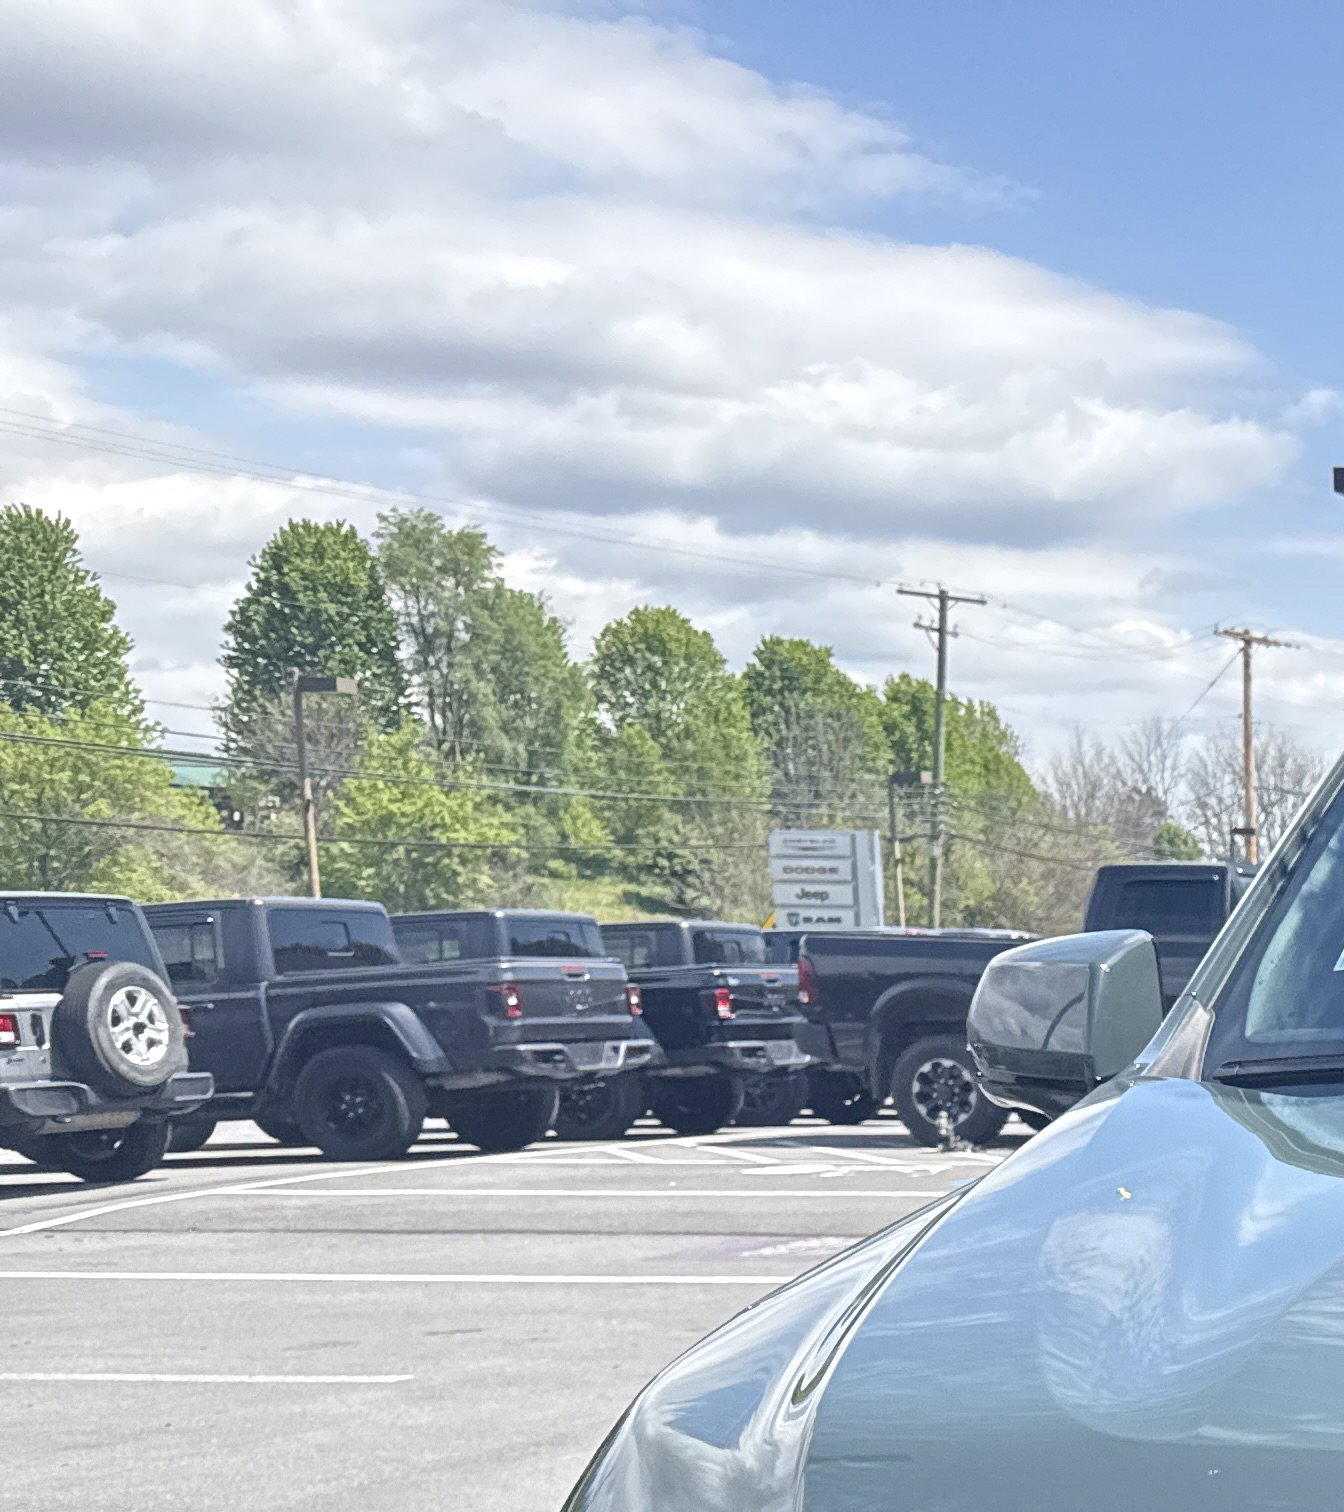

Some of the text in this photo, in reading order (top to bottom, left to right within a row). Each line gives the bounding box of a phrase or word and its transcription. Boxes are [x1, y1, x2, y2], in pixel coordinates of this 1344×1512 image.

[783, 866, 840, 874] DODGE
[796, 887, 829, 902] Jeep
[802, 916, 842, 924] RAM
